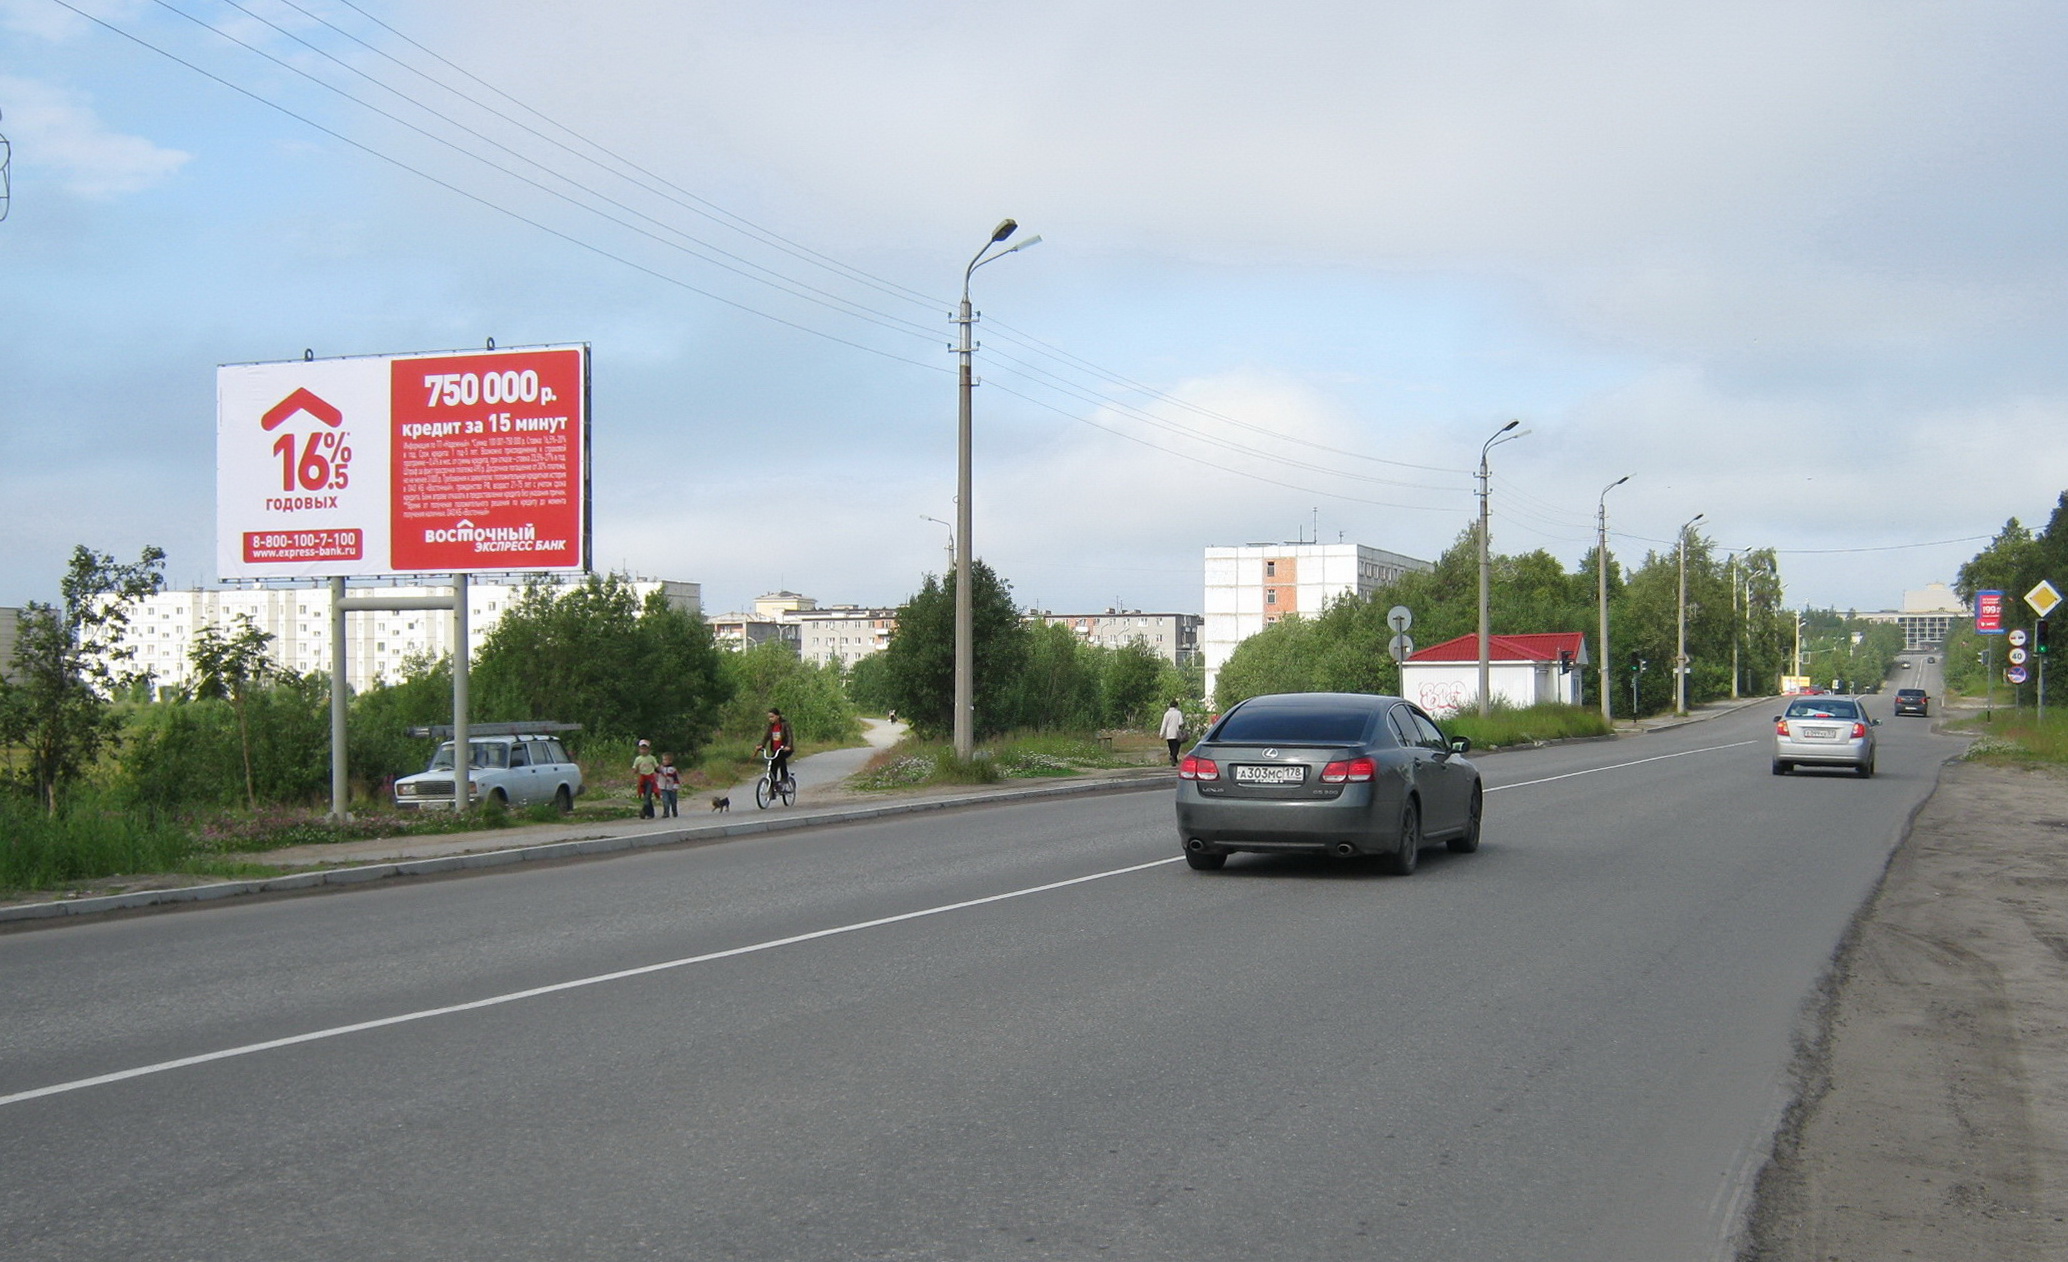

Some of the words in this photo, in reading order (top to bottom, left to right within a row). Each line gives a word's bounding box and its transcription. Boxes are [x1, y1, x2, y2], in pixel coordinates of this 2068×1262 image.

[424, 373, 479, 407] 750
[483, 369, 538, 404] 000
[402, 421, 461, 439] кредит
[465, 420, 484, 434] за
[489, 412, 511, 433] 15
[515, 416, 568, 434] минут
[266, 496, 338, 512] годовых
[253, 533, 355, 548] 8-800-100-7-100
[474, 541, 533, 552] ЭКСПРЕСС
[535, 540, 566, 551] БАНК
[253, 546, 356, 559] www.express-bank.ru
